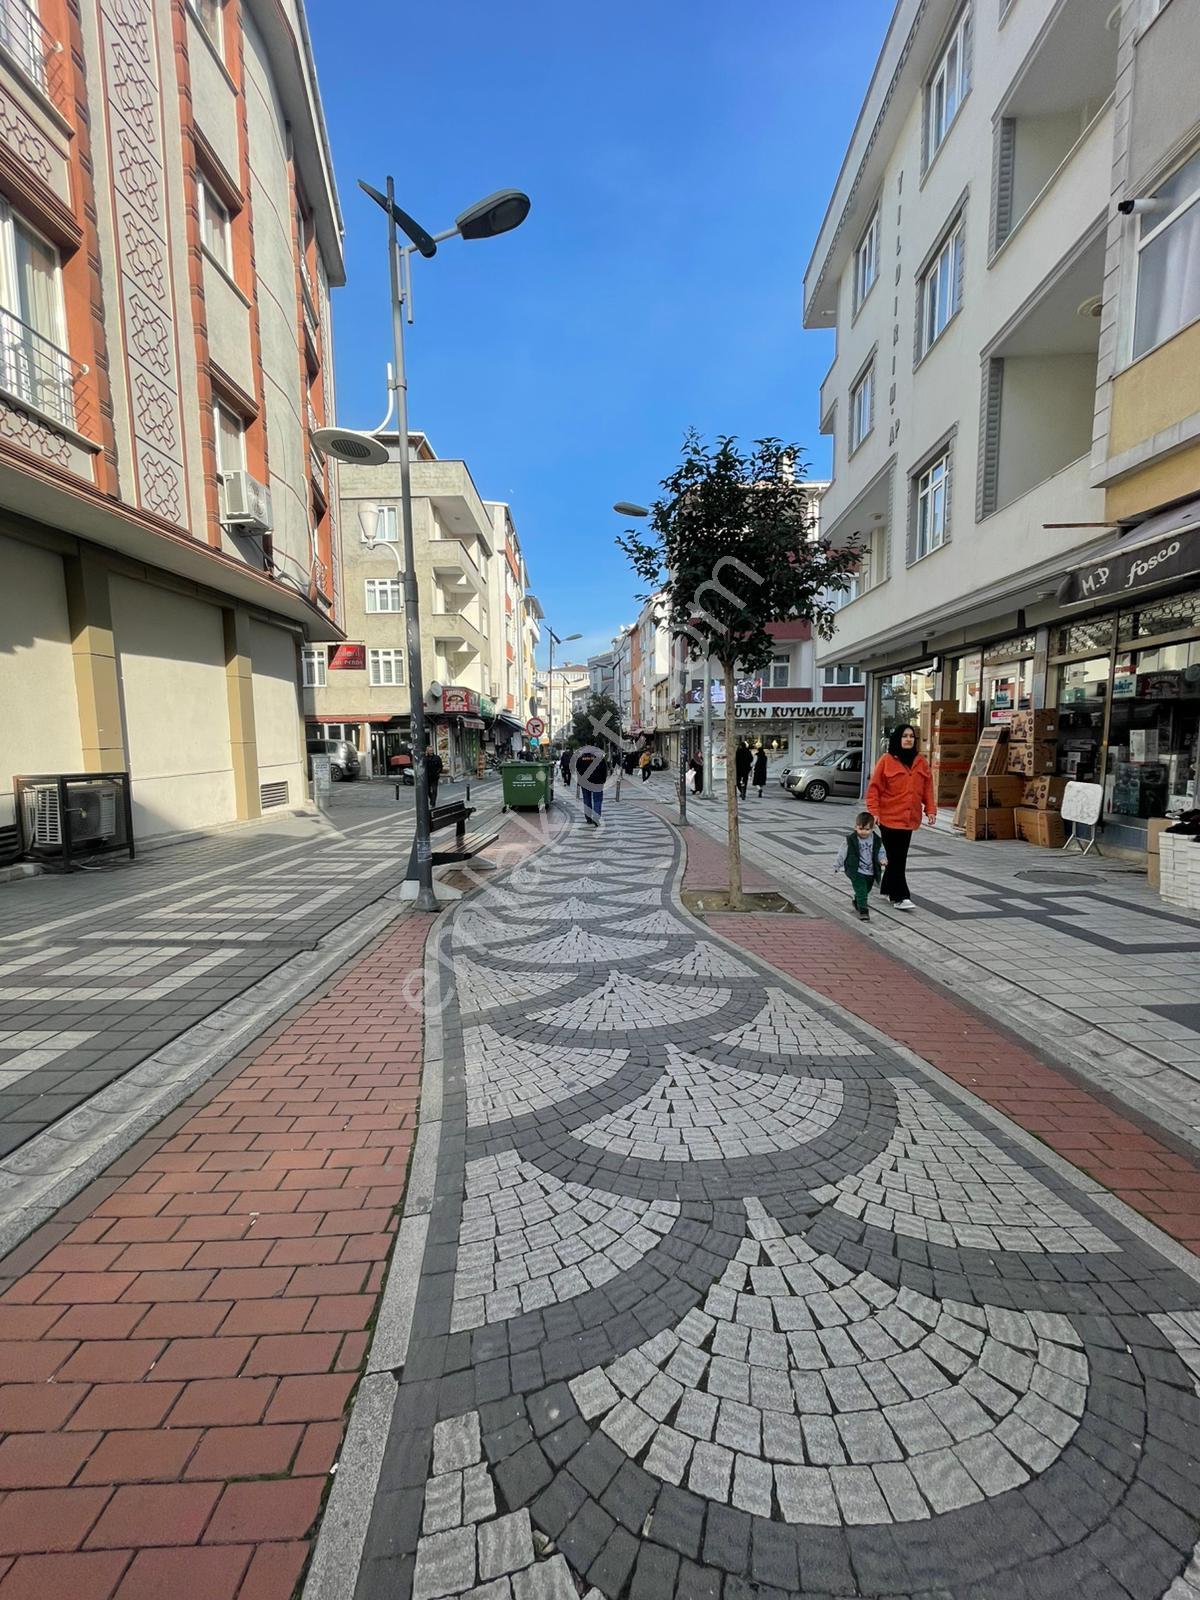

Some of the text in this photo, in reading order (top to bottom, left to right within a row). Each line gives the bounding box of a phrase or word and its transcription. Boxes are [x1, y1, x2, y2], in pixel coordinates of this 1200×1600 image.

[1124, 541, 1180, 588] fosco
[724, 704, 855, 718] ÜVEN KUYUMCULUK
